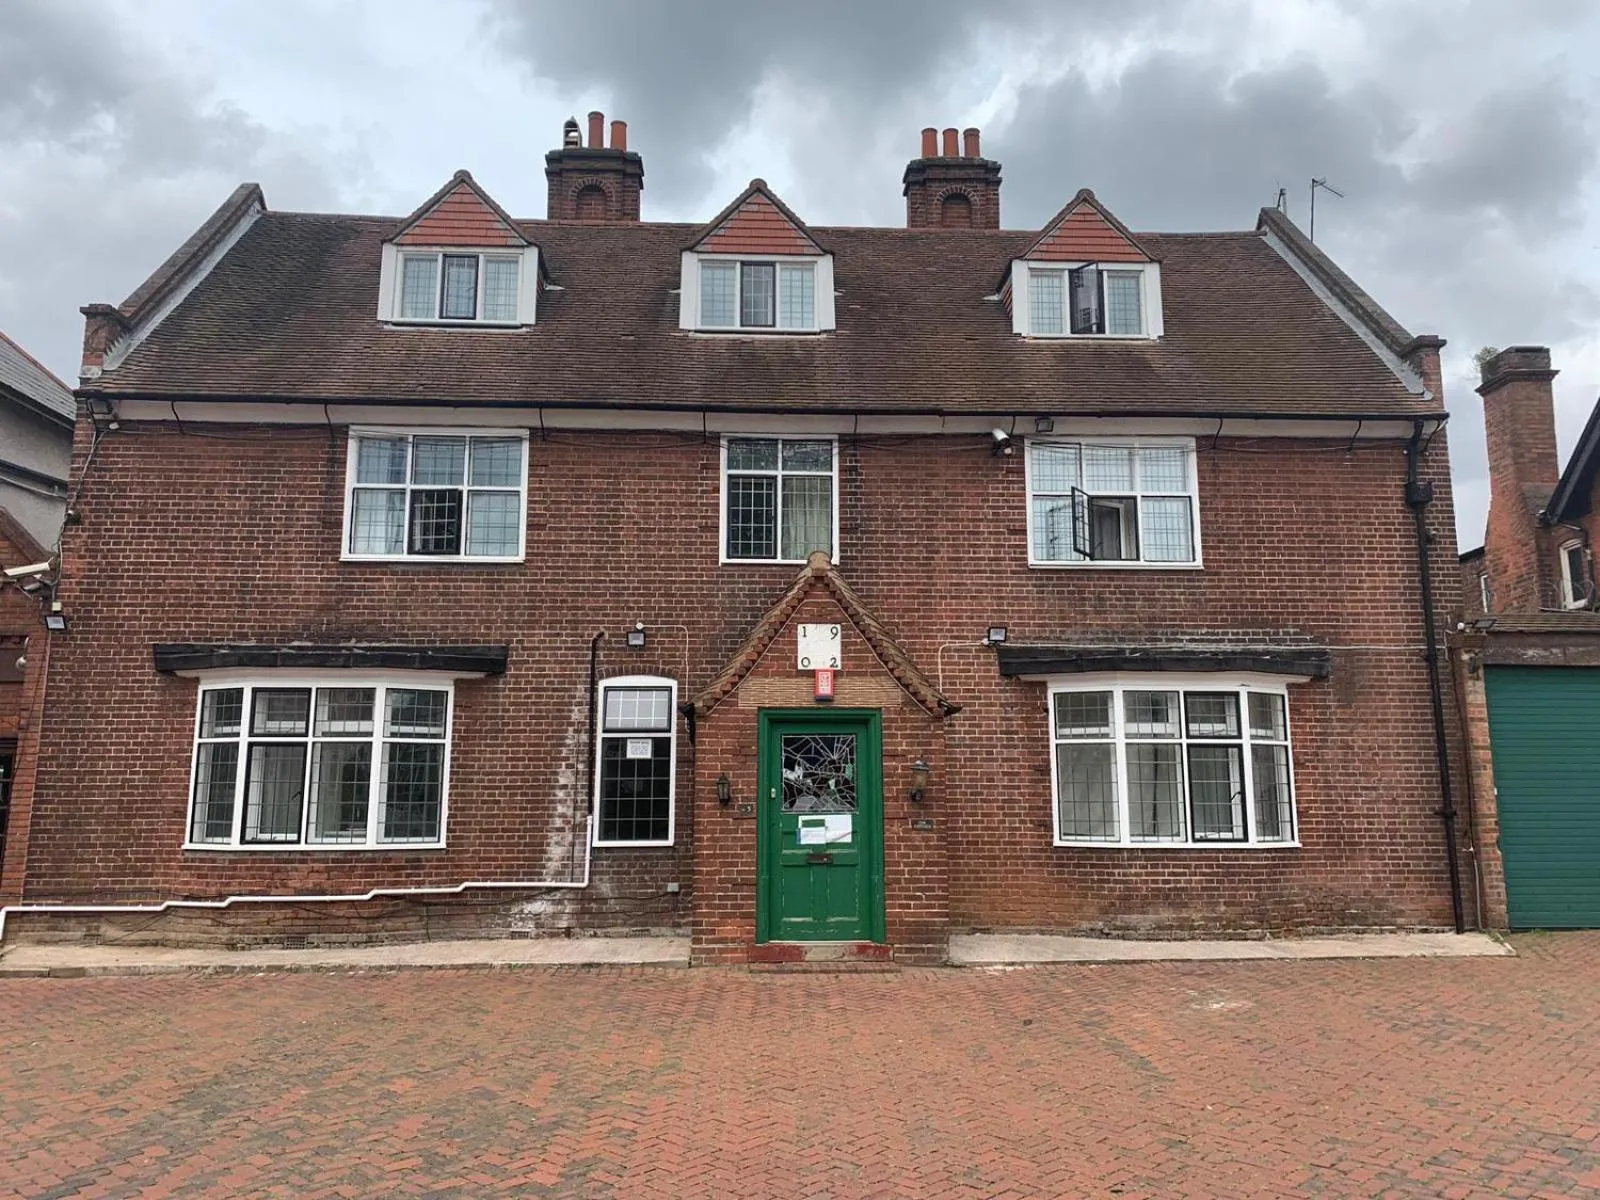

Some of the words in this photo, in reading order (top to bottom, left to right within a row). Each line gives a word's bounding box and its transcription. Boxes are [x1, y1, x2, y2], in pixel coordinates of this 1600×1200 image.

[802, 626, 807, 638] 1
[830, 626, 839, 640] 9
[830, 657, 838, 668] 2
